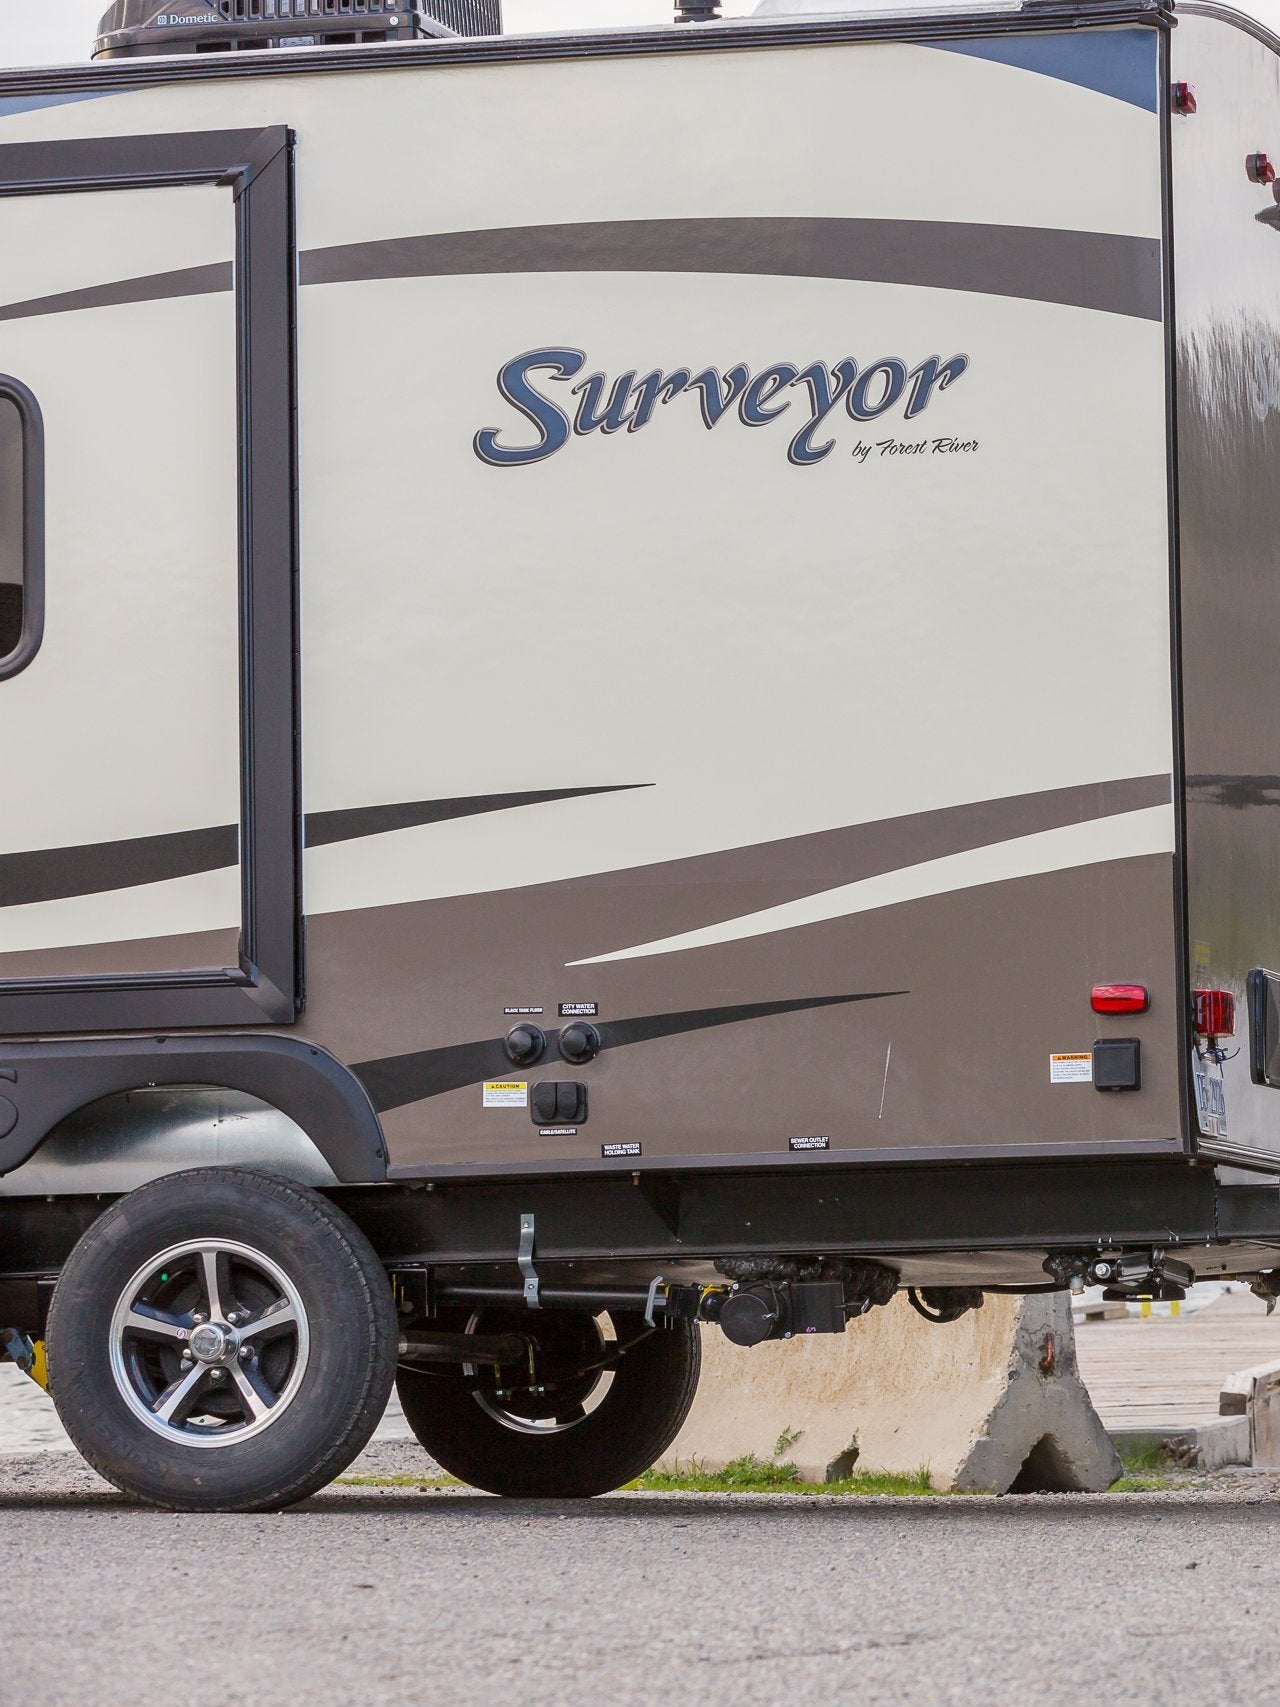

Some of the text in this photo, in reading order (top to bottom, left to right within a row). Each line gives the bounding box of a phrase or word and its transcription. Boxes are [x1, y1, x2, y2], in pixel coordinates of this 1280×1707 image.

[169, 13, 218, 25] Dometic
[473, 346, 970, 467] Surveyor
[852, 437, 979, 463] by Forest River
